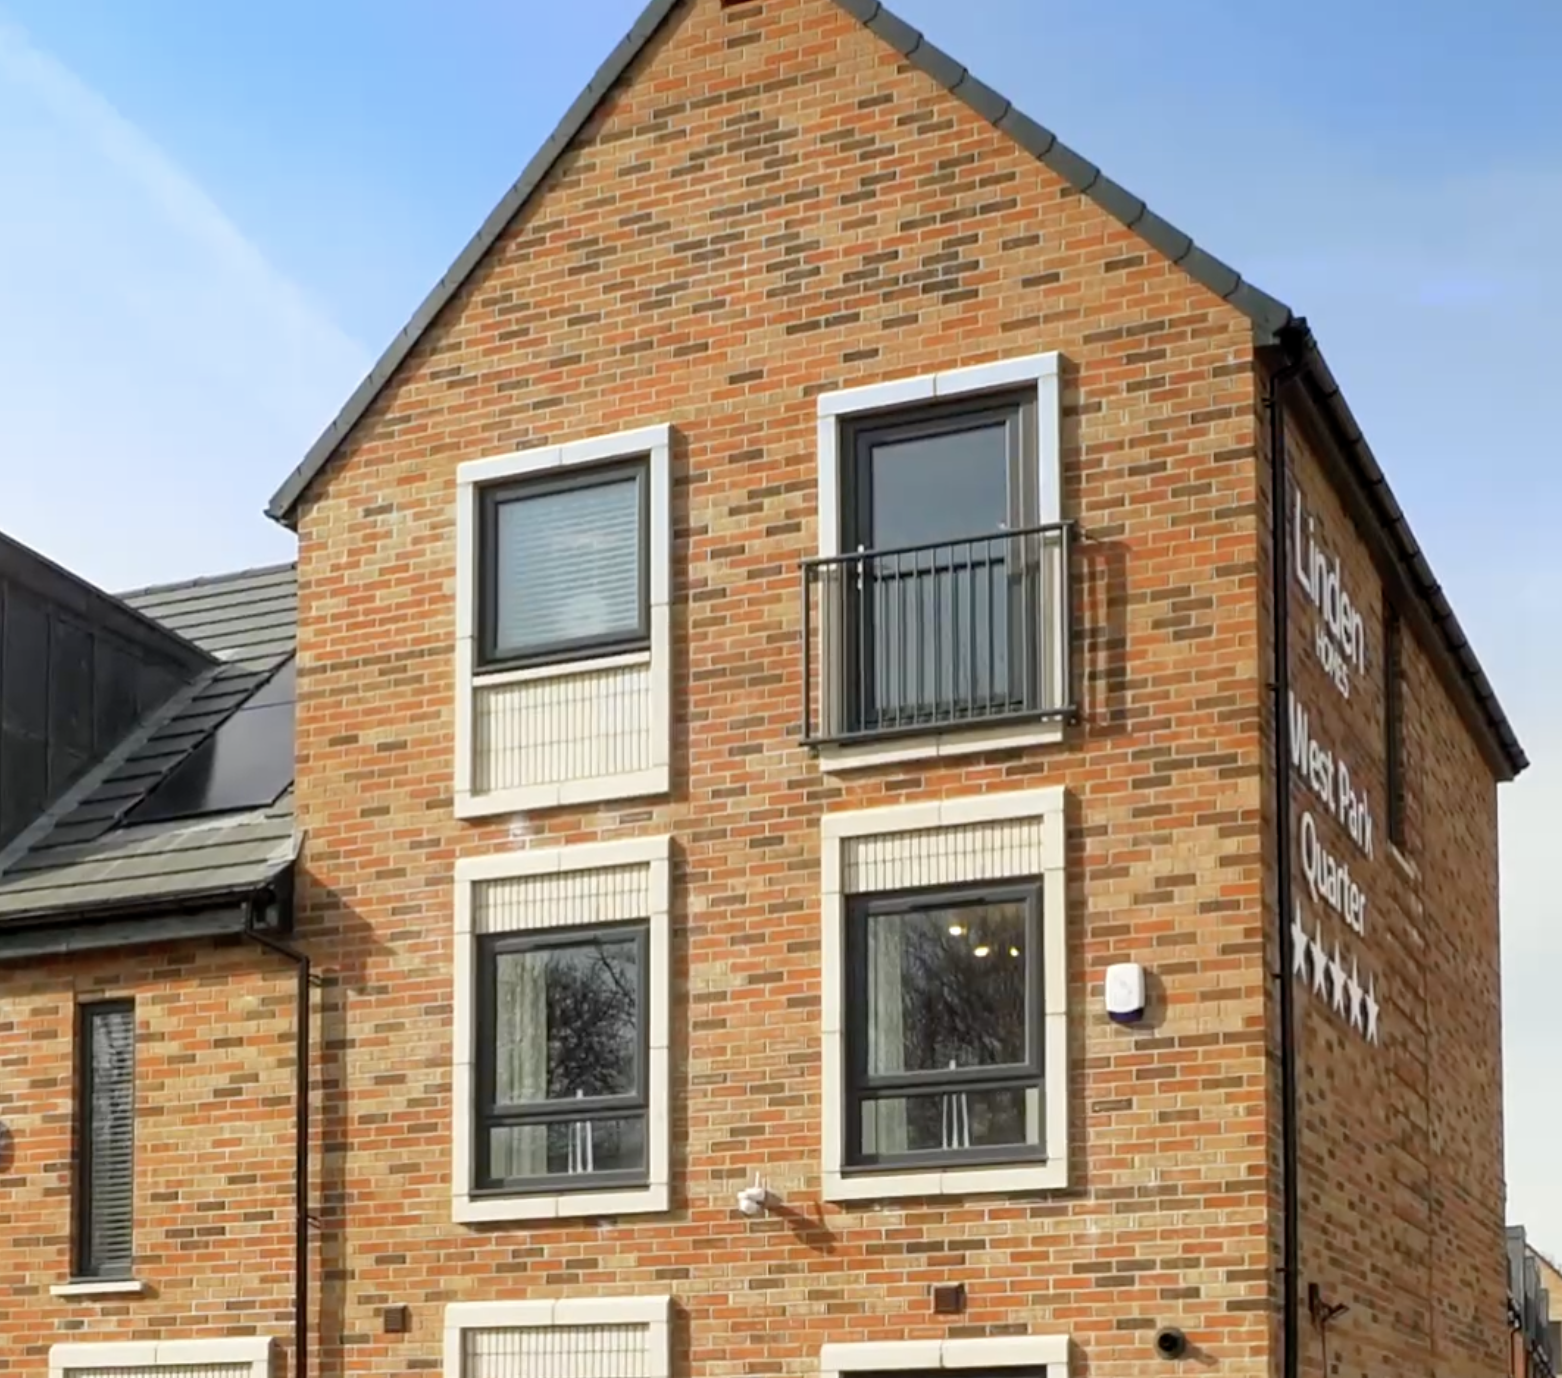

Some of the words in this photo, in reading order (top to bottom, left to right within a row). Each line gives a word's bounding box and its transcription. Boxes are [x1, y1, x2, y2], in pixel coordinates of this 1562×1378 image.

[1296, 488, 1365, 676] Linden
[1315, 622, 1350, 699] HOMES
[1288, 689, 1336, 815] West
[1337, 758, 1374, 862] Park
[1301, 810, 1366, 937] Quarter
